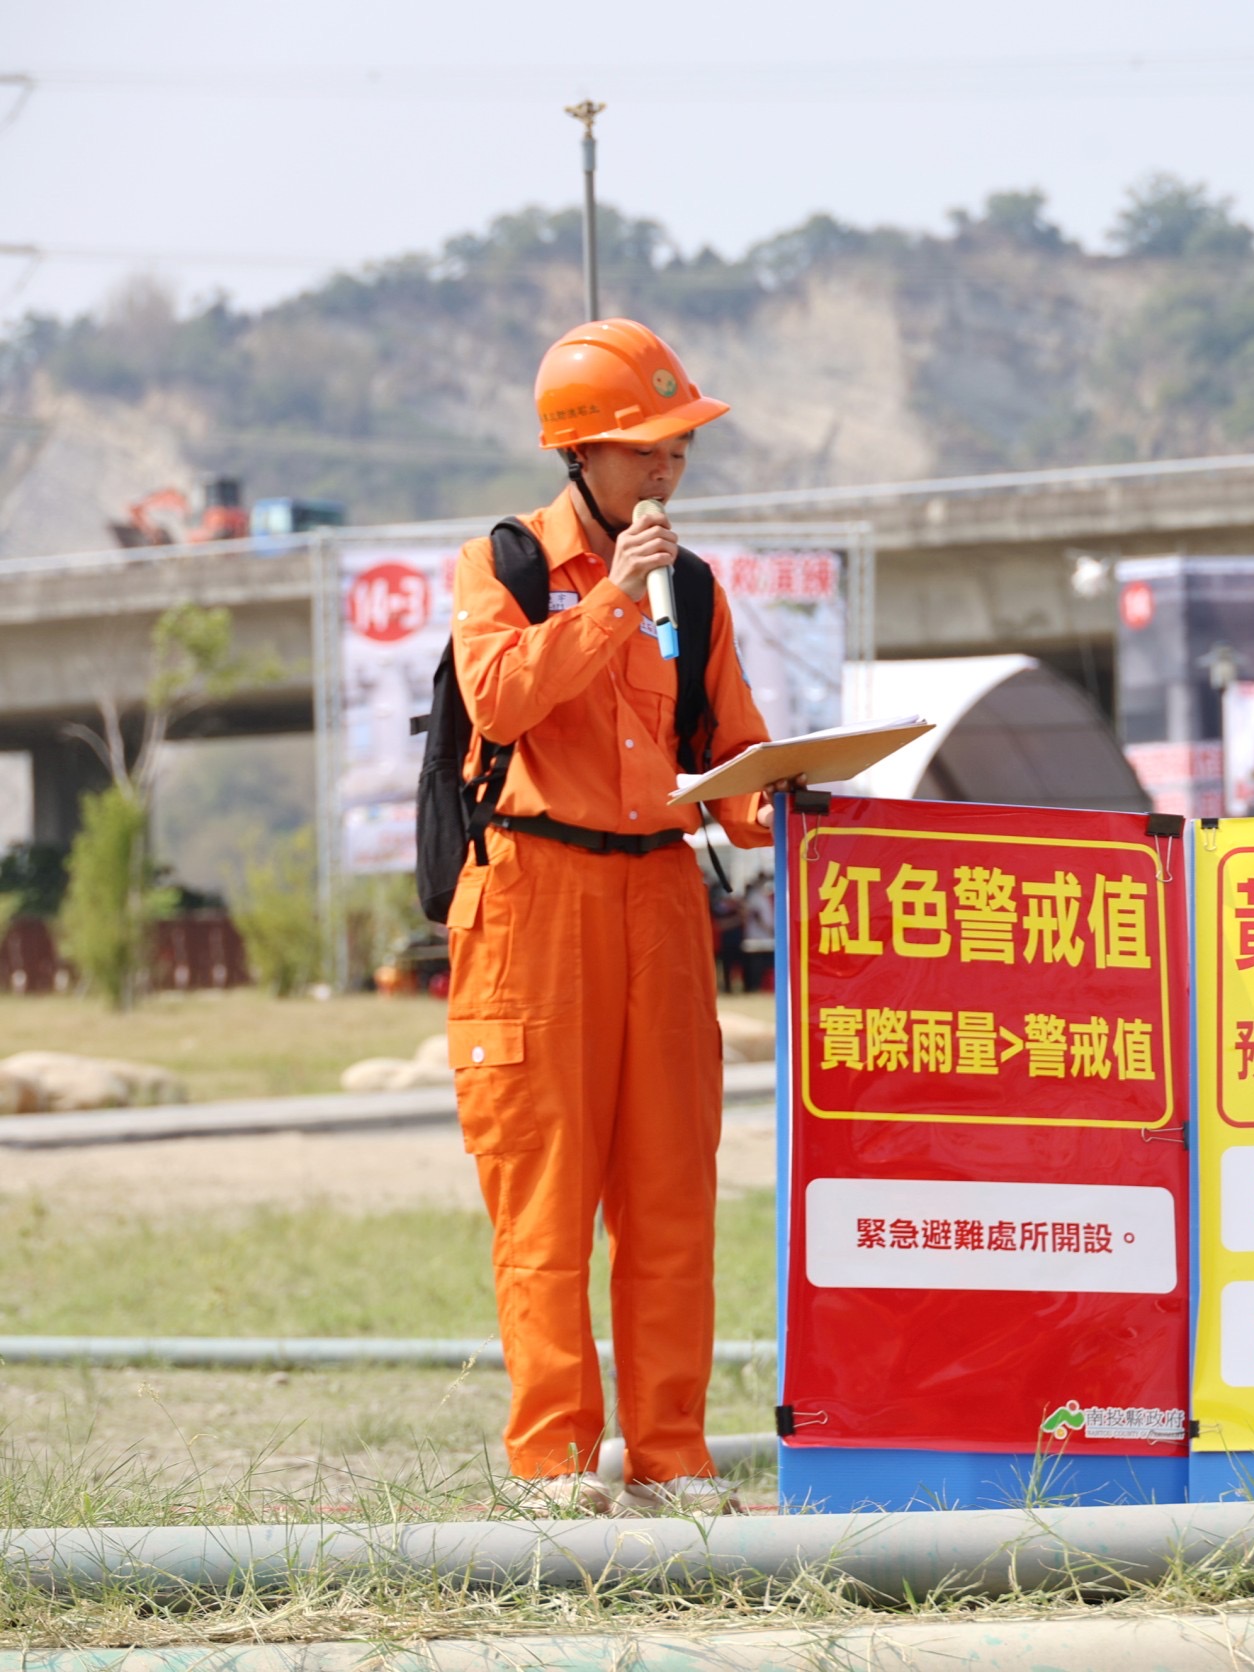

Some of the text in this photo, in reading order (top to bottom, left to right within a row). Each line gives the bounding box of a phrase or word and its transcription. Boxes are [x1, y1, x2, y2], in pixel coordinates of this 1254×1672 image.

[818, 861, 1151, 969] 紅色警戒值
[819, 1005, 1156, 1081] 實際雨量>警戒值
[1086, 1408, 1184, 1428] 南投縣政府
